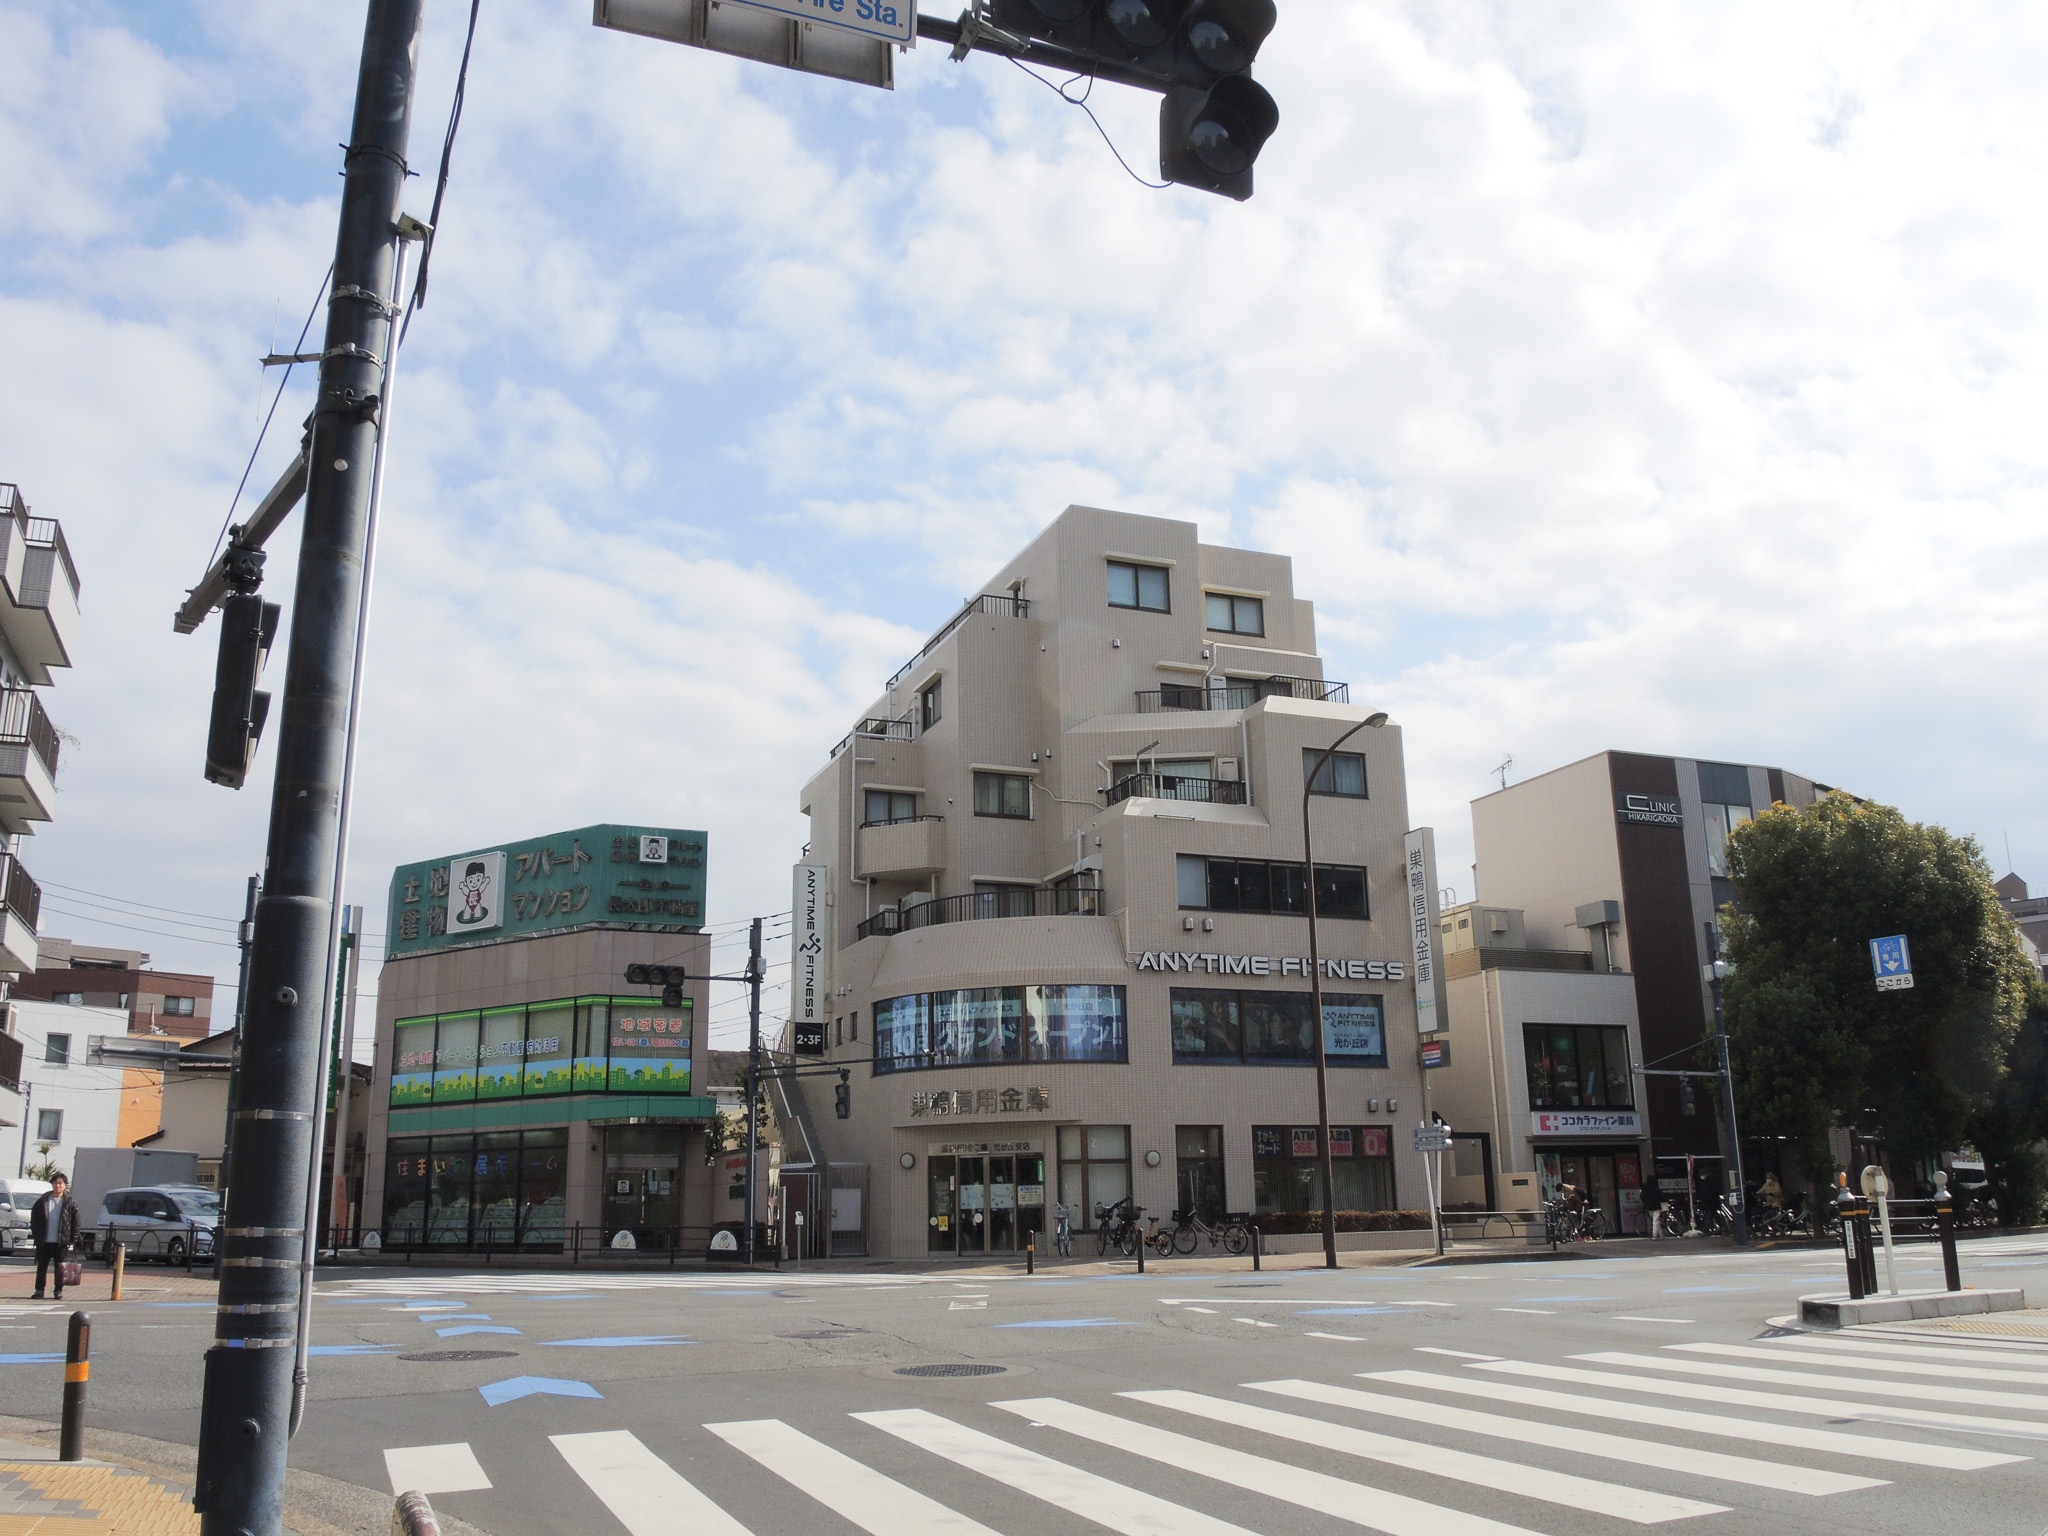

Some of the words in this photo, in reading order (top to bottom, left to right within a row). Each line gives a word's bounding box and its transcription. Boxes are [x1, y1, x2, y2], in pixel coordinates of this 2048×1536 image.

[856, 0, 904, 28] Sta.
[1627, 795, 1677, 813] CLINIC
[1628, 812, 1678, 824] HIKARIGAOKA
[513, 838, 591, 882] アパート
[403, 866, 450, 904] 土地
[511, 882, 591, 922] マンション
[806, 869, 816, 931] ANYTIME
[400, 904, 447, 941] 建物
[1409, 849, 1431, 984] 巣鴨信用金庫
[1138, 950, 1270, 976] ANYTIME
[805, 954, 815, 1019] FITNESS
[1878, 976, 1911, 988] ここから
[620, 1017, 683, 1033] 地域密着
[1338, 1020, 1376, 1028] FITNESS
[911, 1087, 1050, 1117] 巣鴨信用金庫
[1257, 1142, 1280, 1155] カード
[1293, 1130, 1315, 1141] ATM
